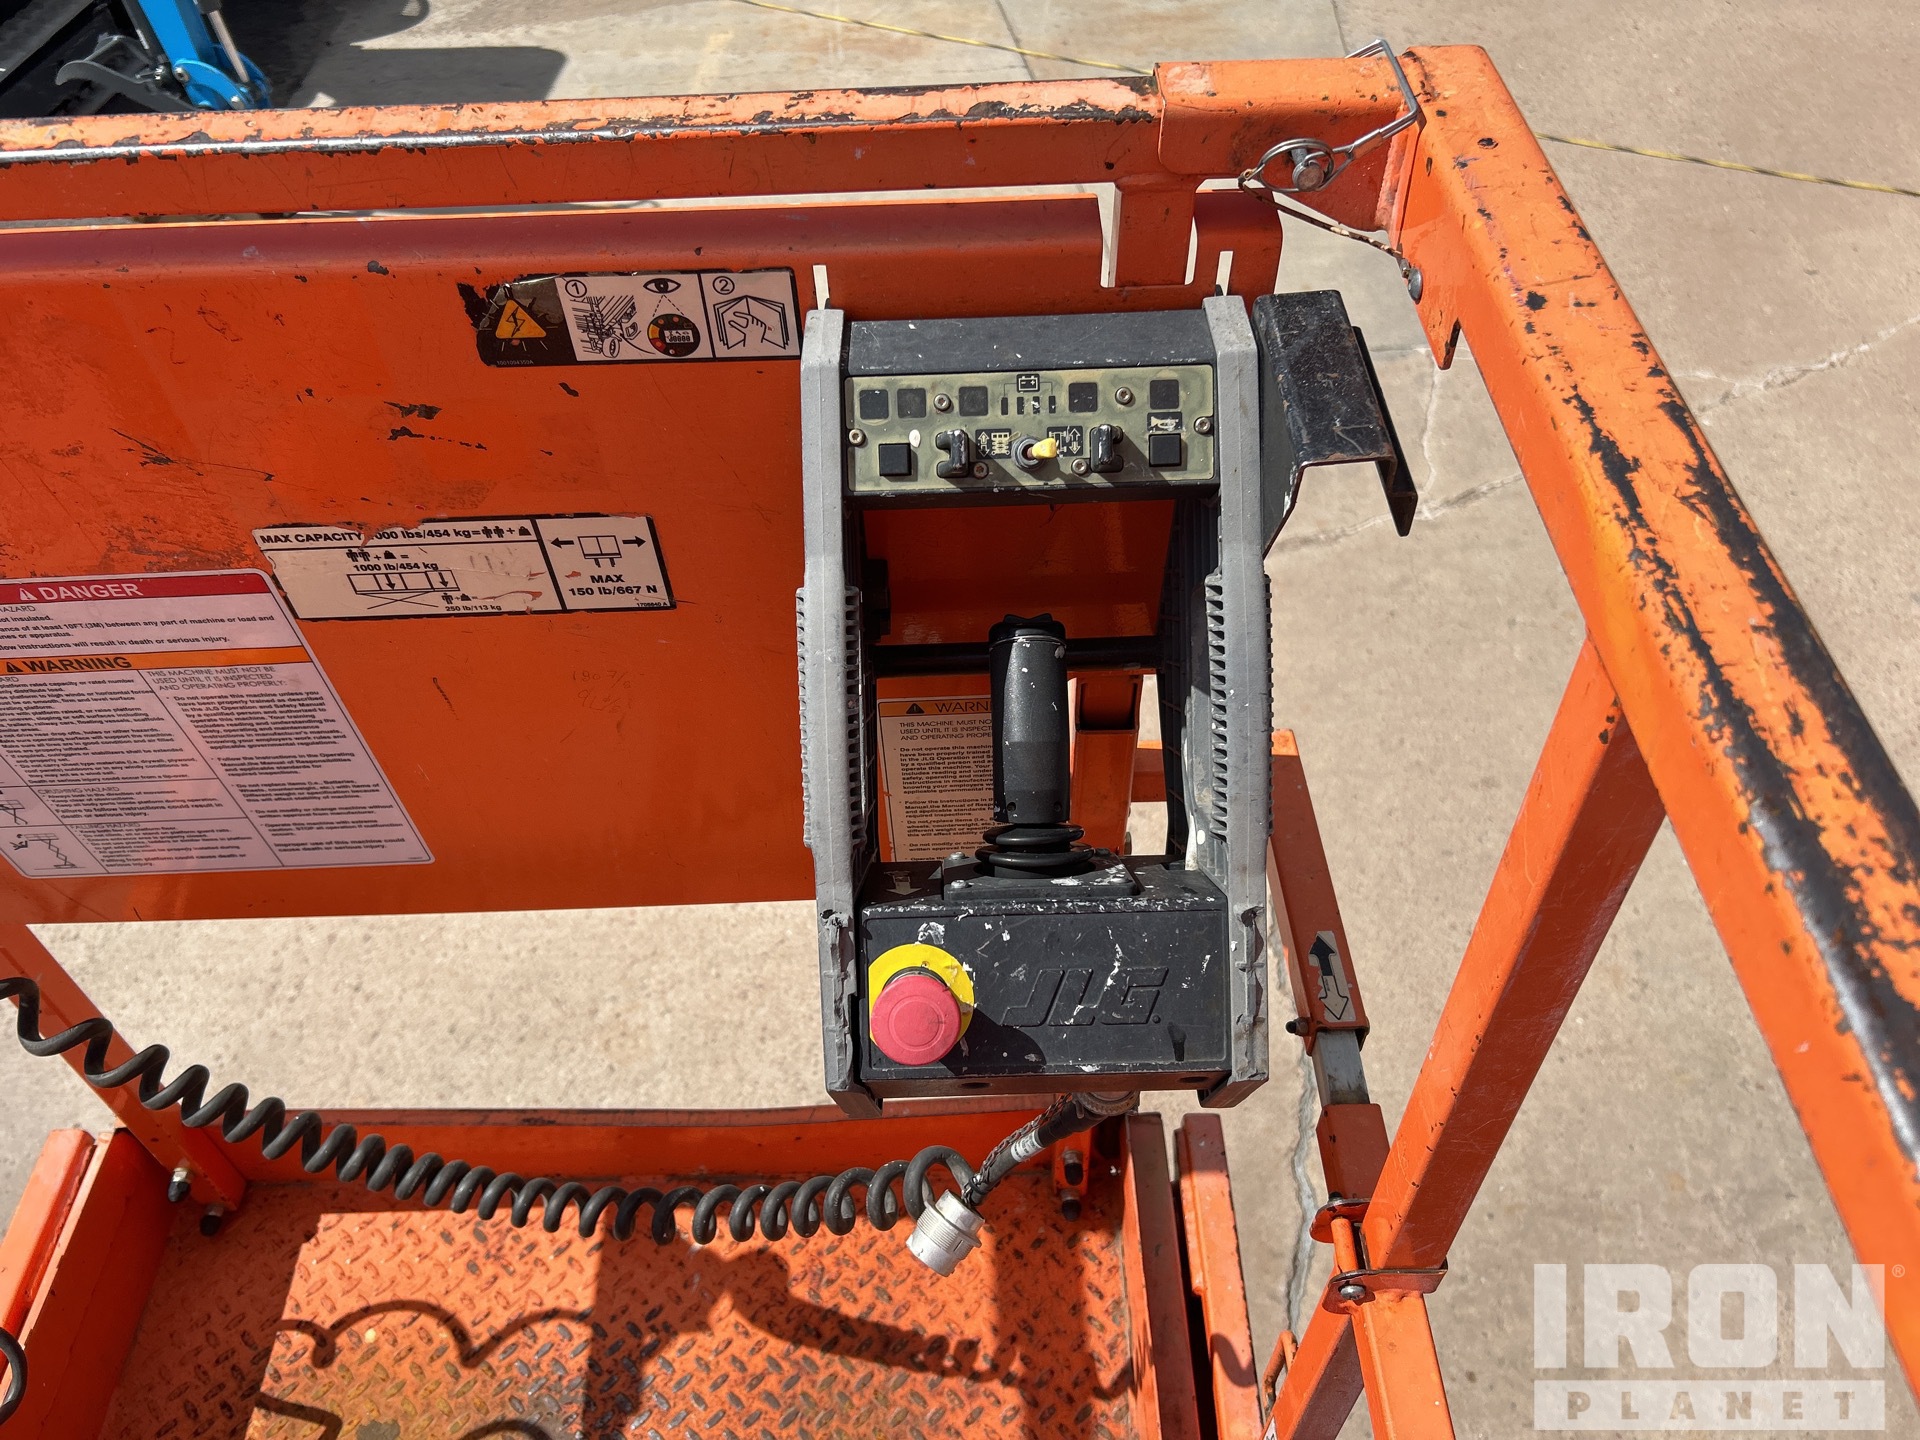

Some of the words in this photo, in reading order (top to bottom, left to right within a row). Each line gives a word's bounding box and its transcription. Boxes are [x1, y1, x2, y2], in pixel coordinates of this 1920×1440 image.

[260, 534, 292, 544] MAX
[295, 532, 363, 543] CAPACITY
[371, 530, 399, 540] 000
[401, 529, 451, 540] lbs/454
[354, 564, 381, 572] 1000
[384, 562, 420, 571] lb/454
[424, 562, 438, 571] kg
[590, 575, 625, 583] MAX
[38, 583, 143, 600] DANGER
[568, 587, 594, 596] 150
[598, 586, 641, 595] lb/667
[645, 585, 658, 594] N
[22, 657, 132, 672] WARNING
[935, 701, 988, 713] WARN
